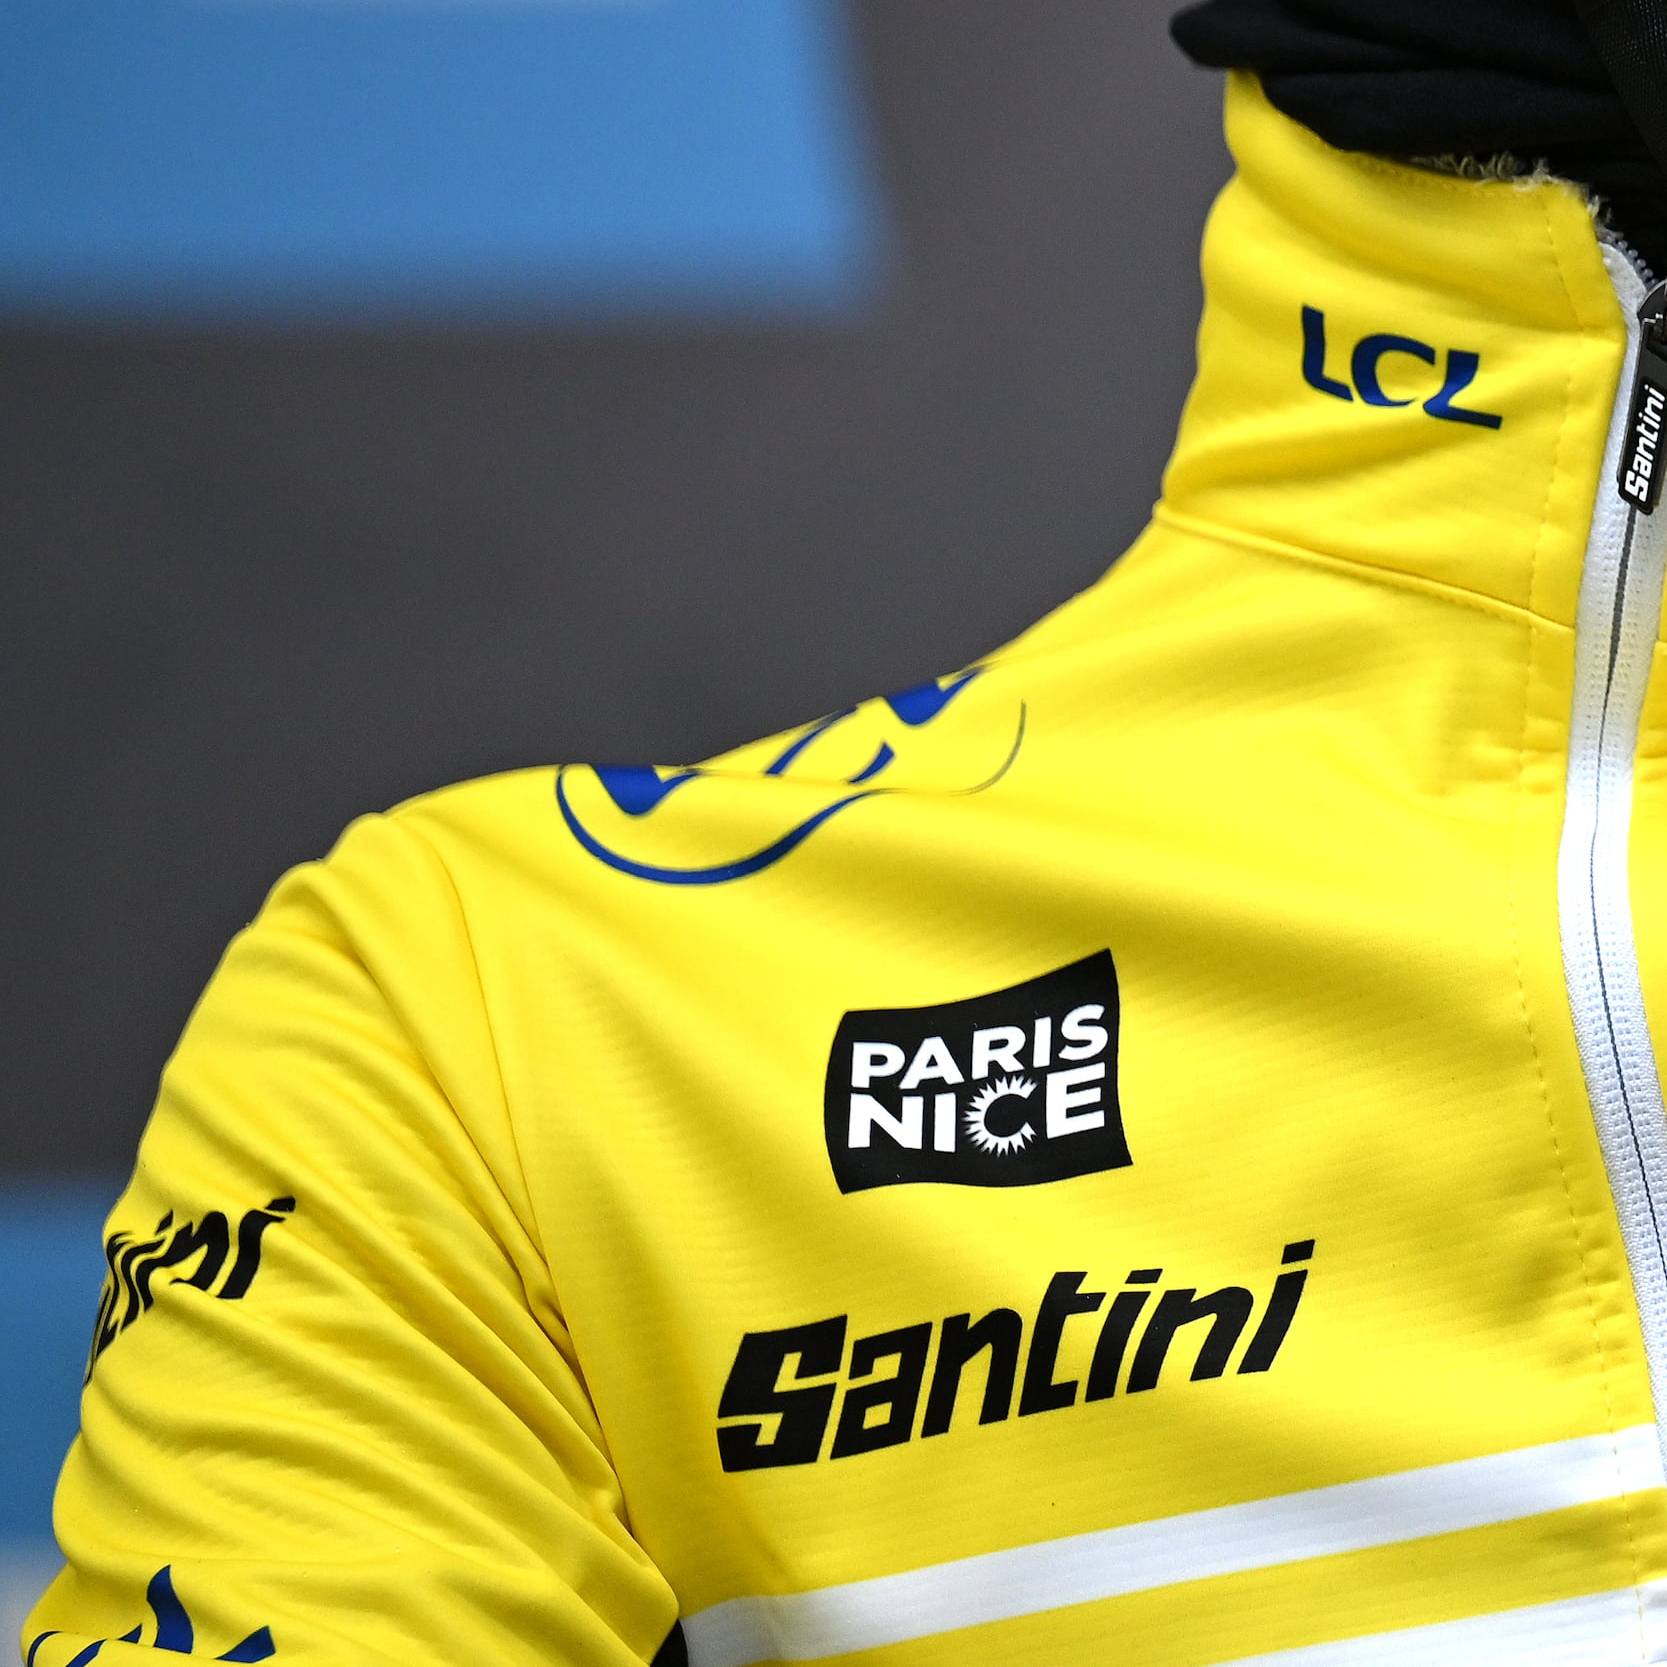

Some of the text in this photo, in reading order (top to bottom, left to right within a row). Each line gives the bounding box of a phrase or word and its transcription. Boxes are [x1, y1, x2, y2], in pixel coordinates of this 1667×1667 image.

[1301, 304, 1503, 431] LCL
[1624, 384, 1667, 503] Santini
[850, 1002, 1109, 1089] PARIS
[847, 1062, 1106, 1157] NICE
[715, 1237, 1316, 1473] Santini
